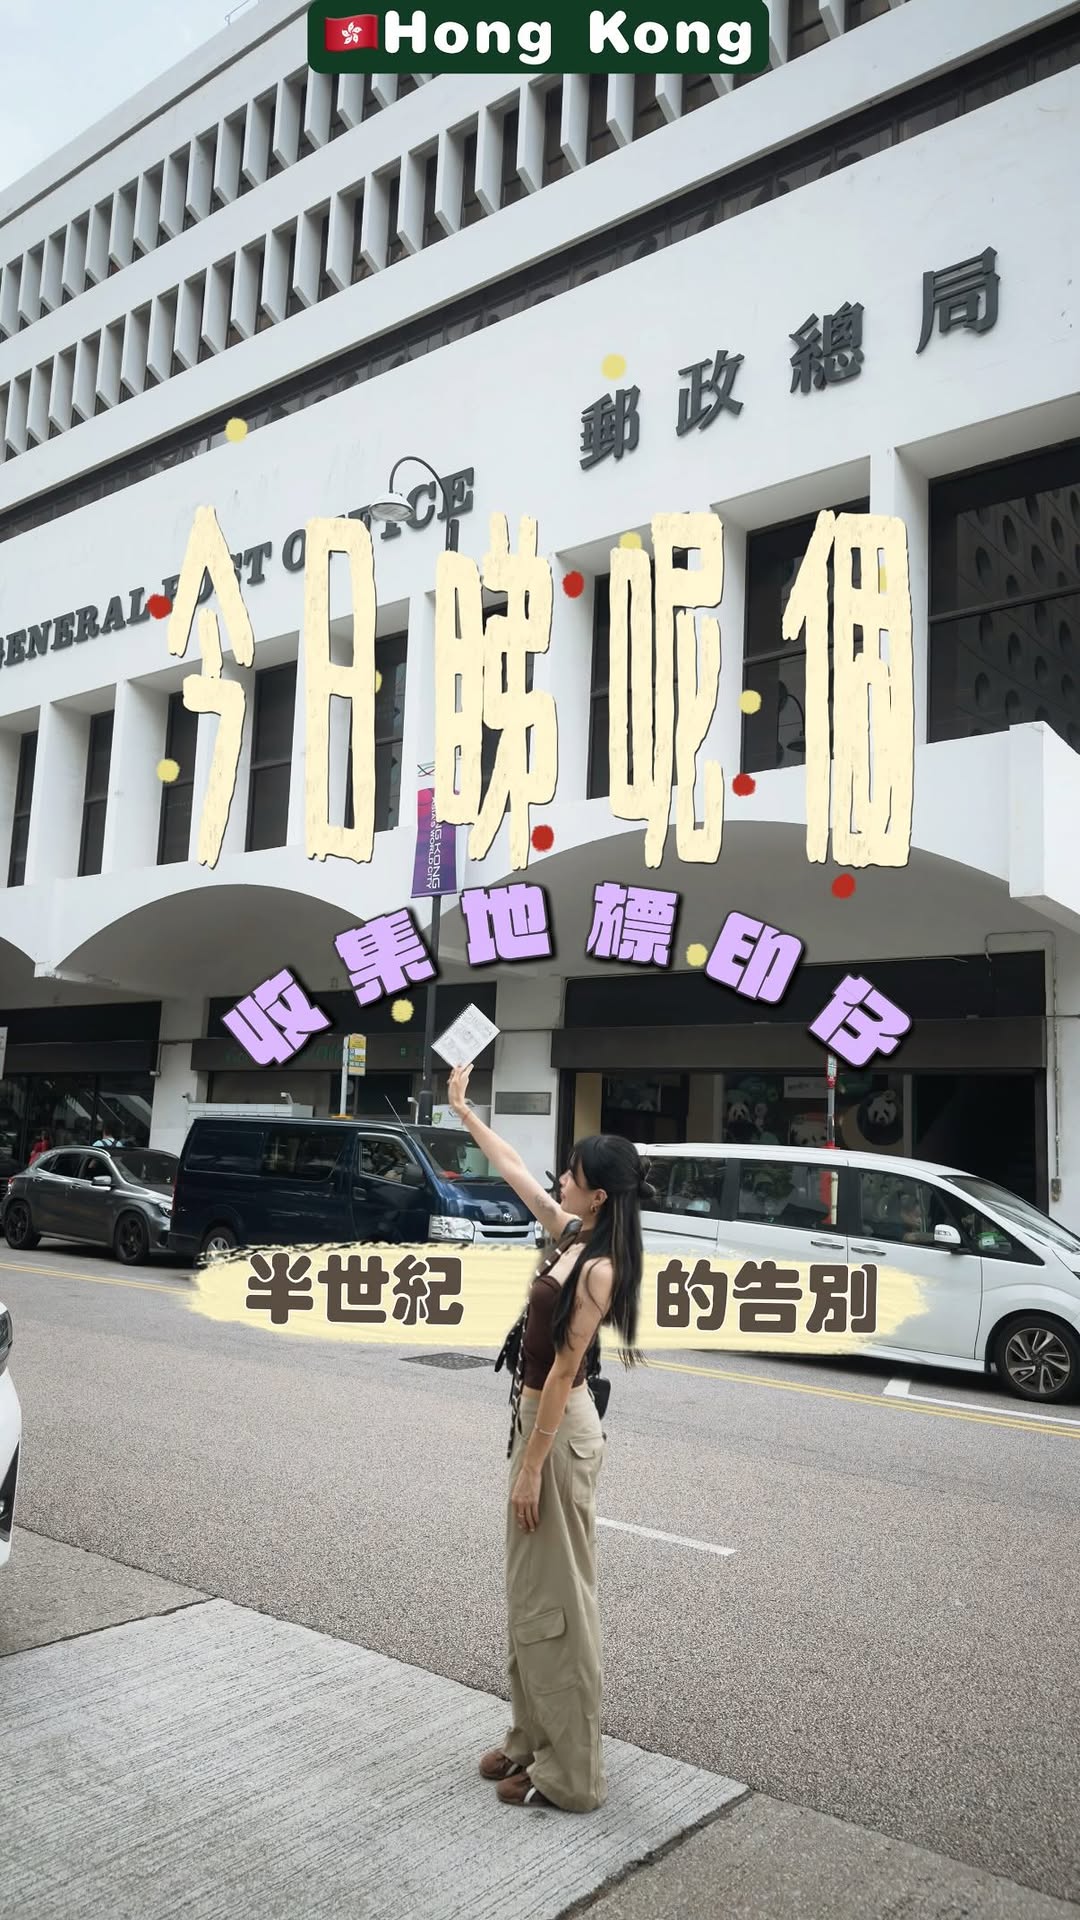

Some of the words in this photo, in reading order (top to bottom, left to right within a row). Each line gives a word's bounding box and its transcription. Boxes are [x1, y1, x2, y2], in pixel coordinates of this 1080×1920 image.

[579, 246, 1001, 472] 郵政總局
[0, 587, 151, 668] ENERAL
[432, 843, 441, 888] KONG
